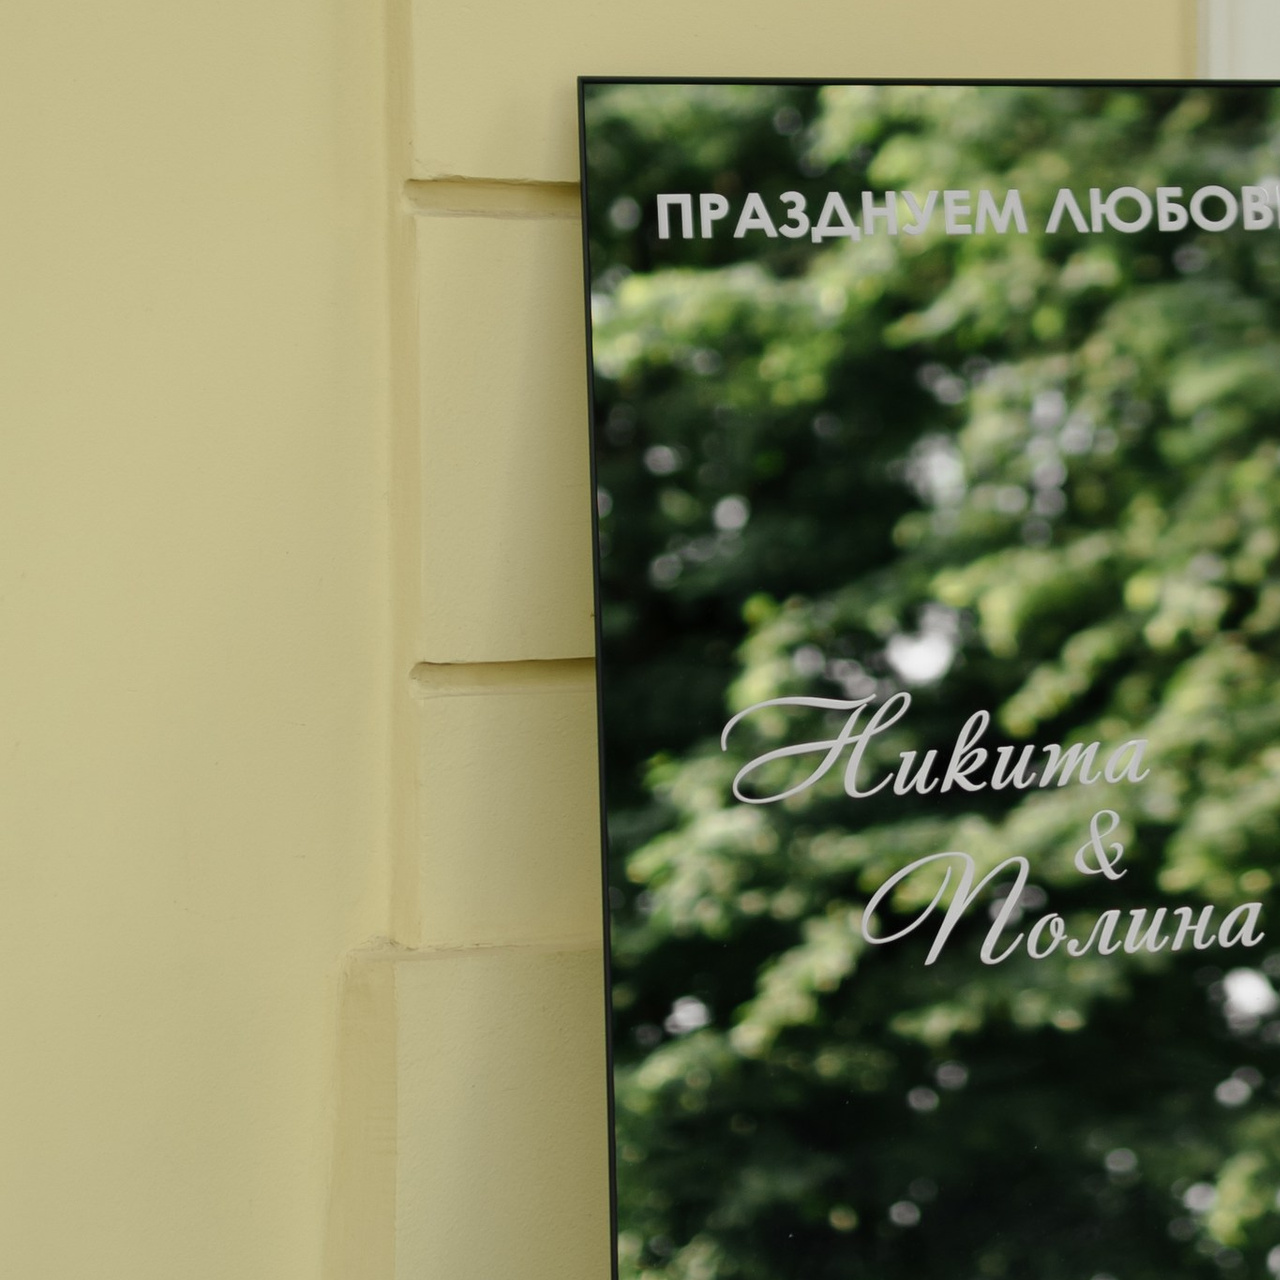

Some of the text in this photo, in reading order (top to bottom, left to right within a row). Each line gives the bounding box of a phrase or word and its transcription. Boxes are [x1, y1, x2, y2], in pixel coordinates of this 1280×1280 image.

[656, 190, 1027, 244] ПРАЗДНУЕМ
[721, 691, 1151, 805] Никита
[1075, 809, 1128, 880] &
[861, 851, 1265, 966] Полина
